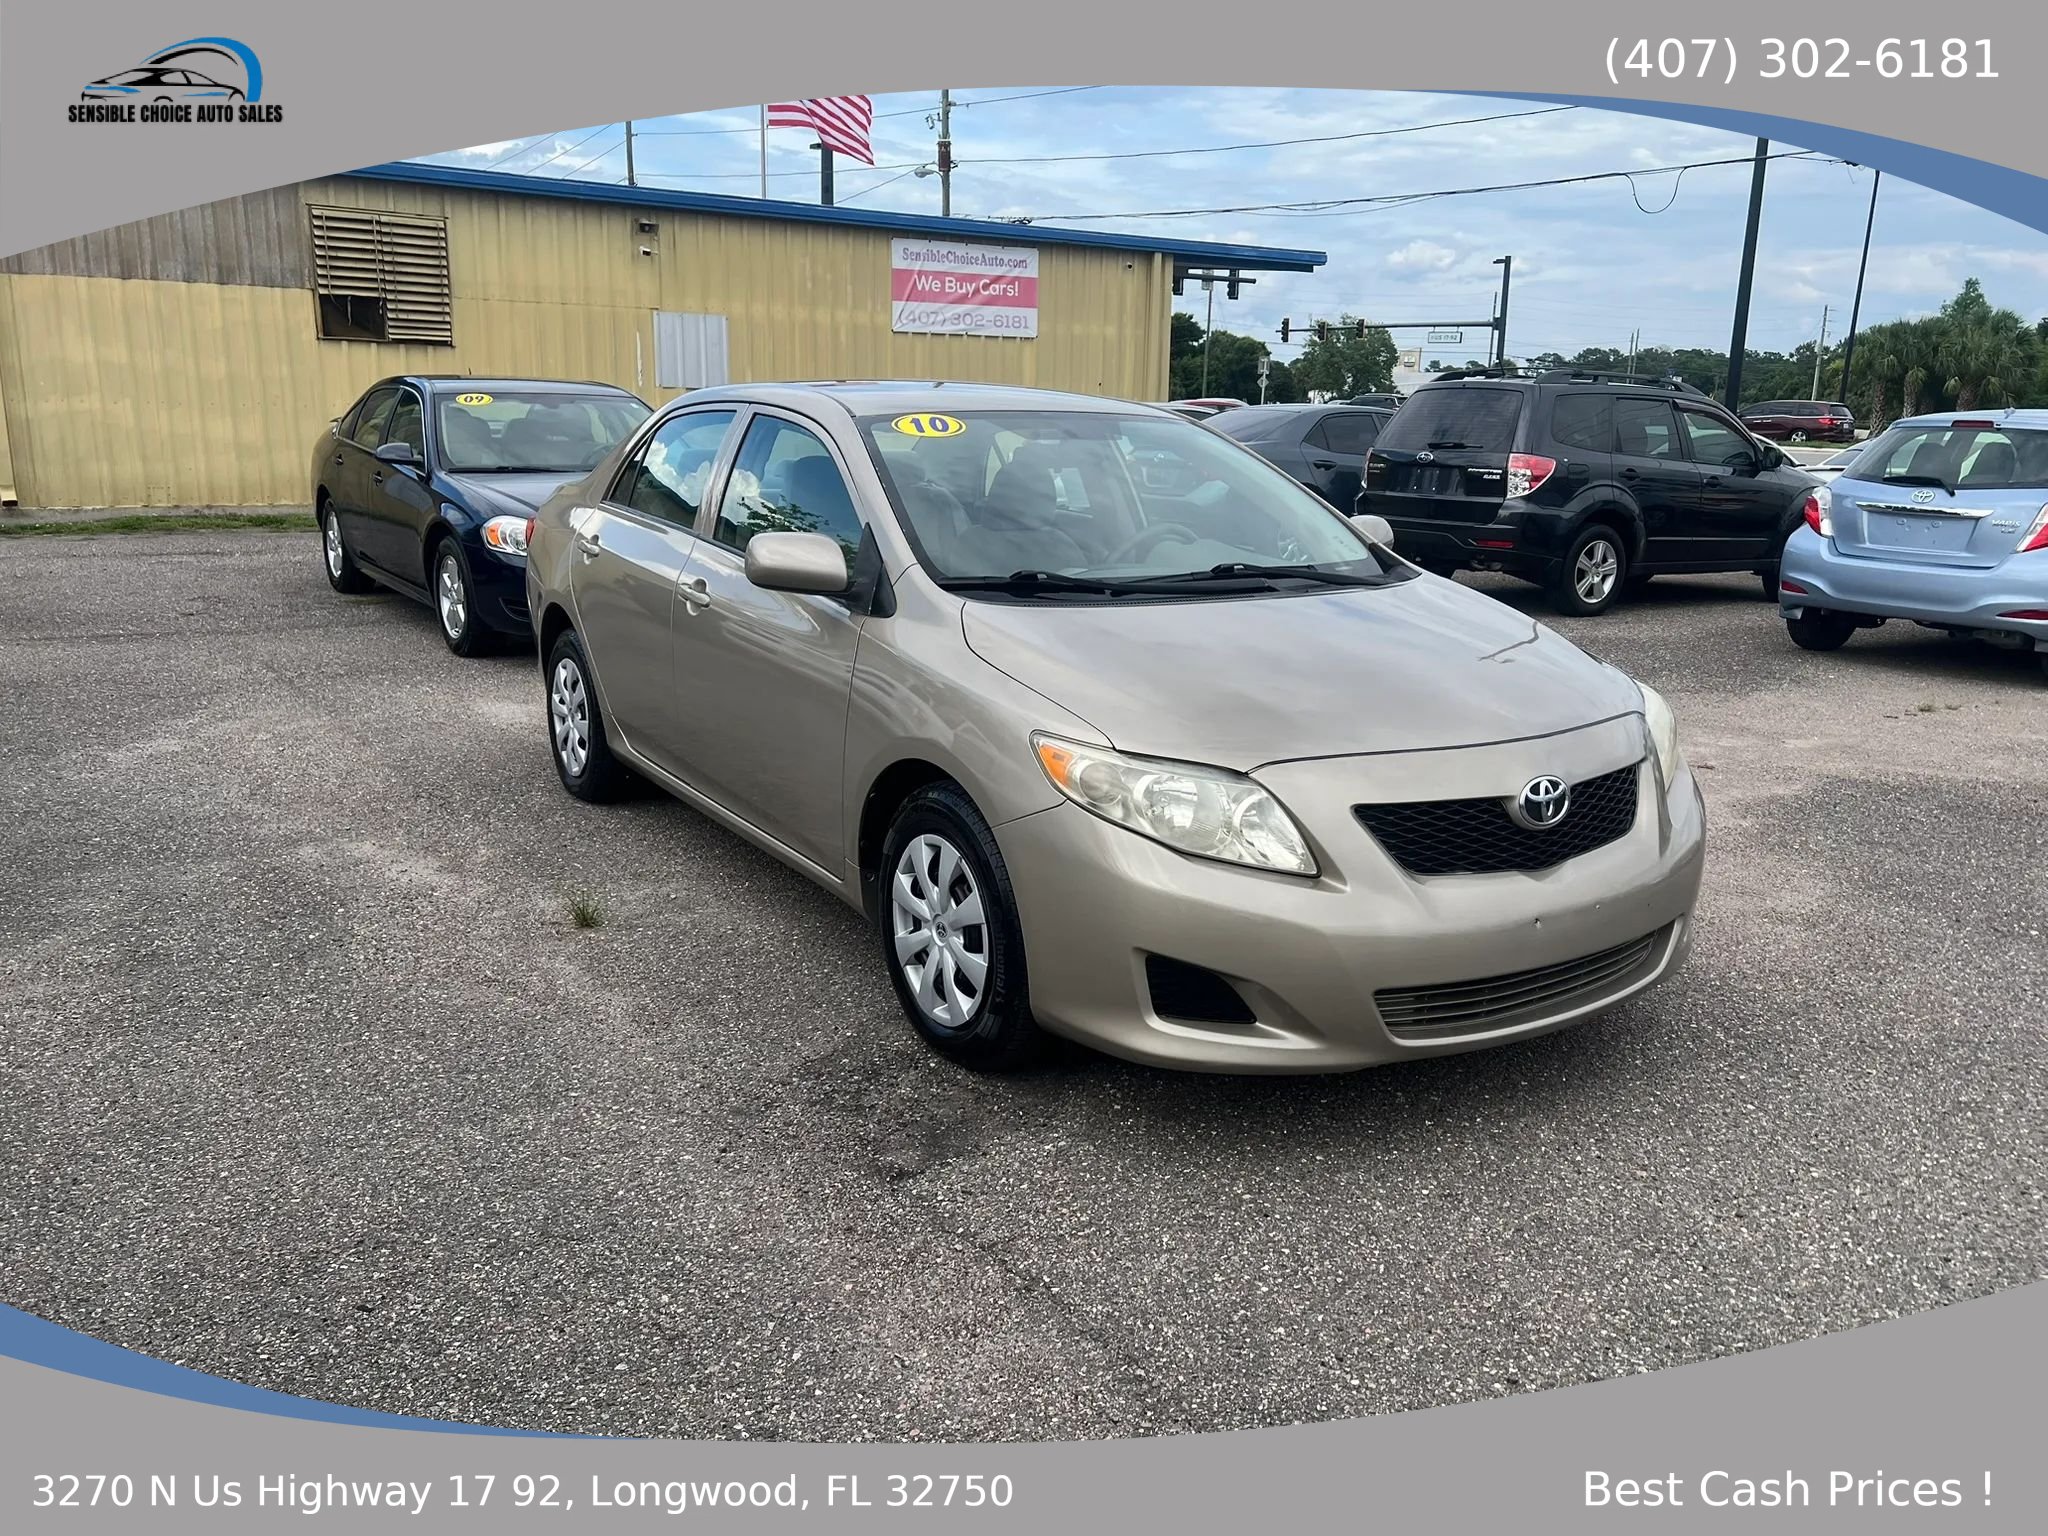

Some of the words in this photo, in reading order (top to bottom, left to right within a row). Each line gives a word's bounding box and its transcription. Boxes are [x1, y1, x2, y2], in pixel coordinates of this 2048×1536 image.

[902, 247, 1028, 269] SensibleChoiceAuto.com
[914, 274, 941, 292] We
[945, 277, 976, 298] Buy
[979, 279, 1019, 297] Cars!
[899, 310, 946, 328] (407)
[950, 312, 1029, 329] 302-6181
[464, 395, 485, 403] 09
[909, 416, 950, 433] 10
